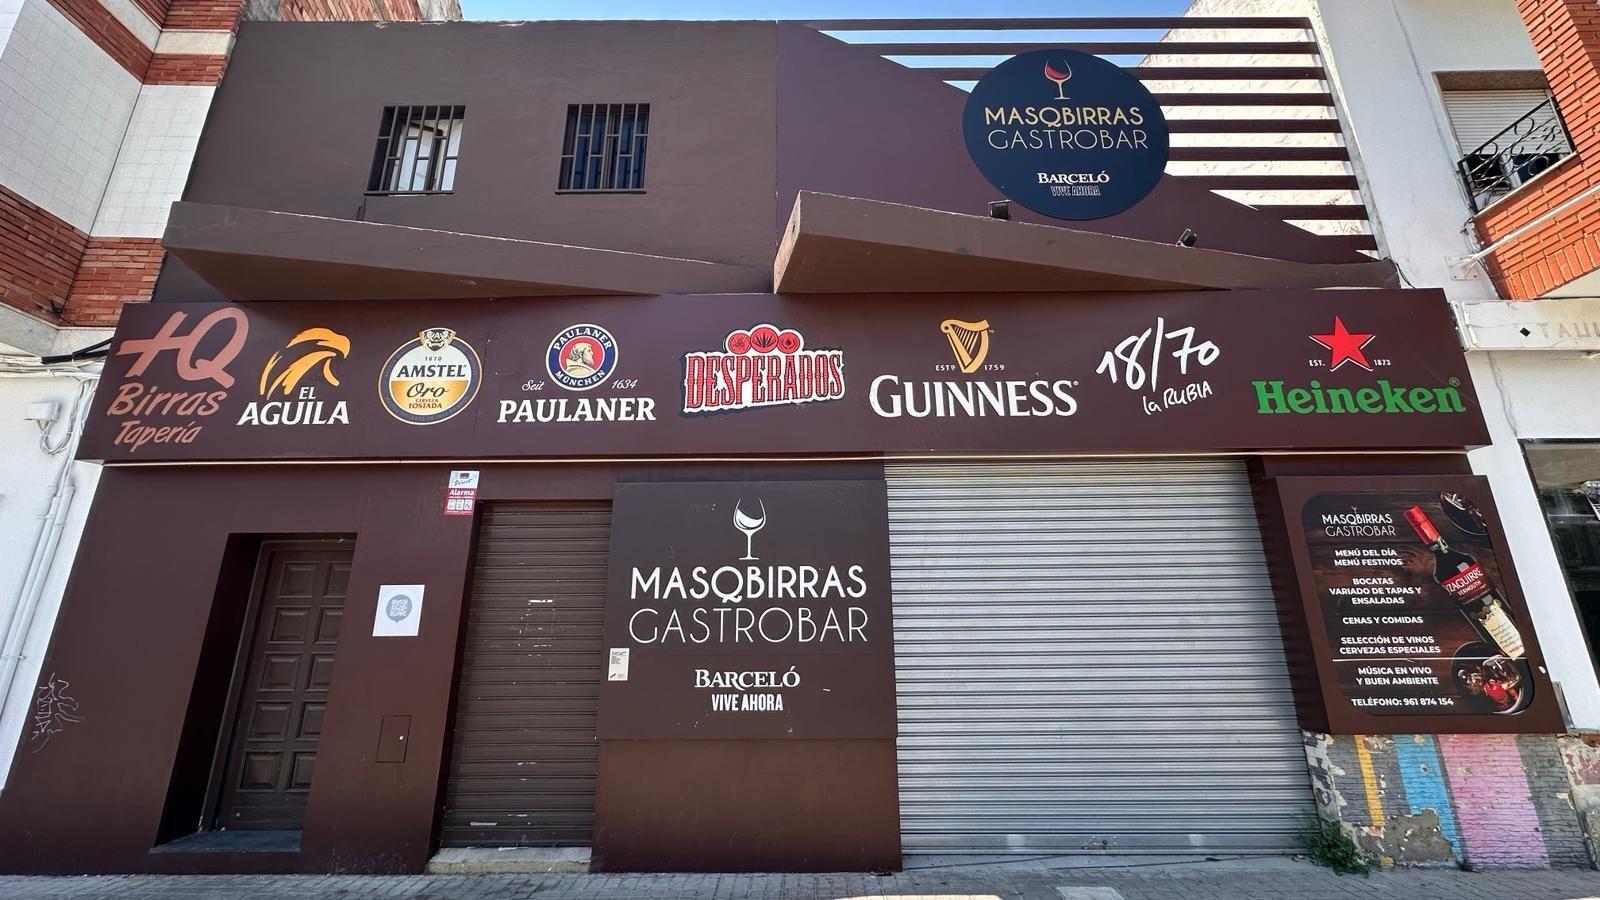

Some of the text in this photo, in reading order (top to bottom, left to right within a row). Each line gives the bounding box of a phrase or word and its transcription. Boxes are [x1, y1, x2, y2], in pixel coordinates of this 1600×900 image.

[984, 107, 1144, 127] MASQBIRRAS
[988, 129, 1148, 150] GASTROBAR
[1037, 170, 1110, 185] BARCELÓ
[1050, 185, 1101, 196] VIVE AHORA
[553, 328, 612, 350] PAULANER
[1096, 316, 1220, 392] 18/70
[396, 364, 466, 378] AMSTEL
[555, 370, 606, 386] MÜNCHEN
[406, 382, 450, 398] Oro
[521, 378, 638, 391] Seit 1634
[683, 351, 845, 413] DESPERADOS
[106, 382, 228, 416] Birras
[298, 386, 317, 400] EL
[868, 374, 1078, 418] GUINNESS
[1142, 380, 1214, 416] la RUBIA
[1252, 380, 1466, 414] Heineken
[236, 400, 350, 426] AGUILA
[497, 397, 656, 422] PAULANER
[113, 420, 202, 452] Tapería
[1322, 514, 1393, 525] MASQBIRRAS
[1325, 526, 1396, 536] GASTROBAR
[1334, 548, 1360, 556] MENÚ
[1381, 548, 1398, 556] DÍA
[1334, 558, 1360, 566] MENÚ
[630, 565, 868, 603] MASQBIRRAS
[1351, 596, 1405, 605] ENSALADAS
[628, 607, 868, 644] GASTROBAR
[1342, 616, 1372, 624] CENAS
[1381, 616, 1424, 624] COMIDAS
[1340, 635, 1391, 645] SELECCIÓN
[1340, 646, 1441, 655] CERVEZAS ESPECIALES
[694, 666, 801, 690] BARCELÓ
[1358, 666, 1432, 675] MÚSICA EN VIVO
[1356, 676, 1440, 686] Y BUEN AMBIENTE
[711, 694, 784, 712] VIVE AHORA
[1351, 697, 1454, 706] TELÉFONO: 961 874 154
